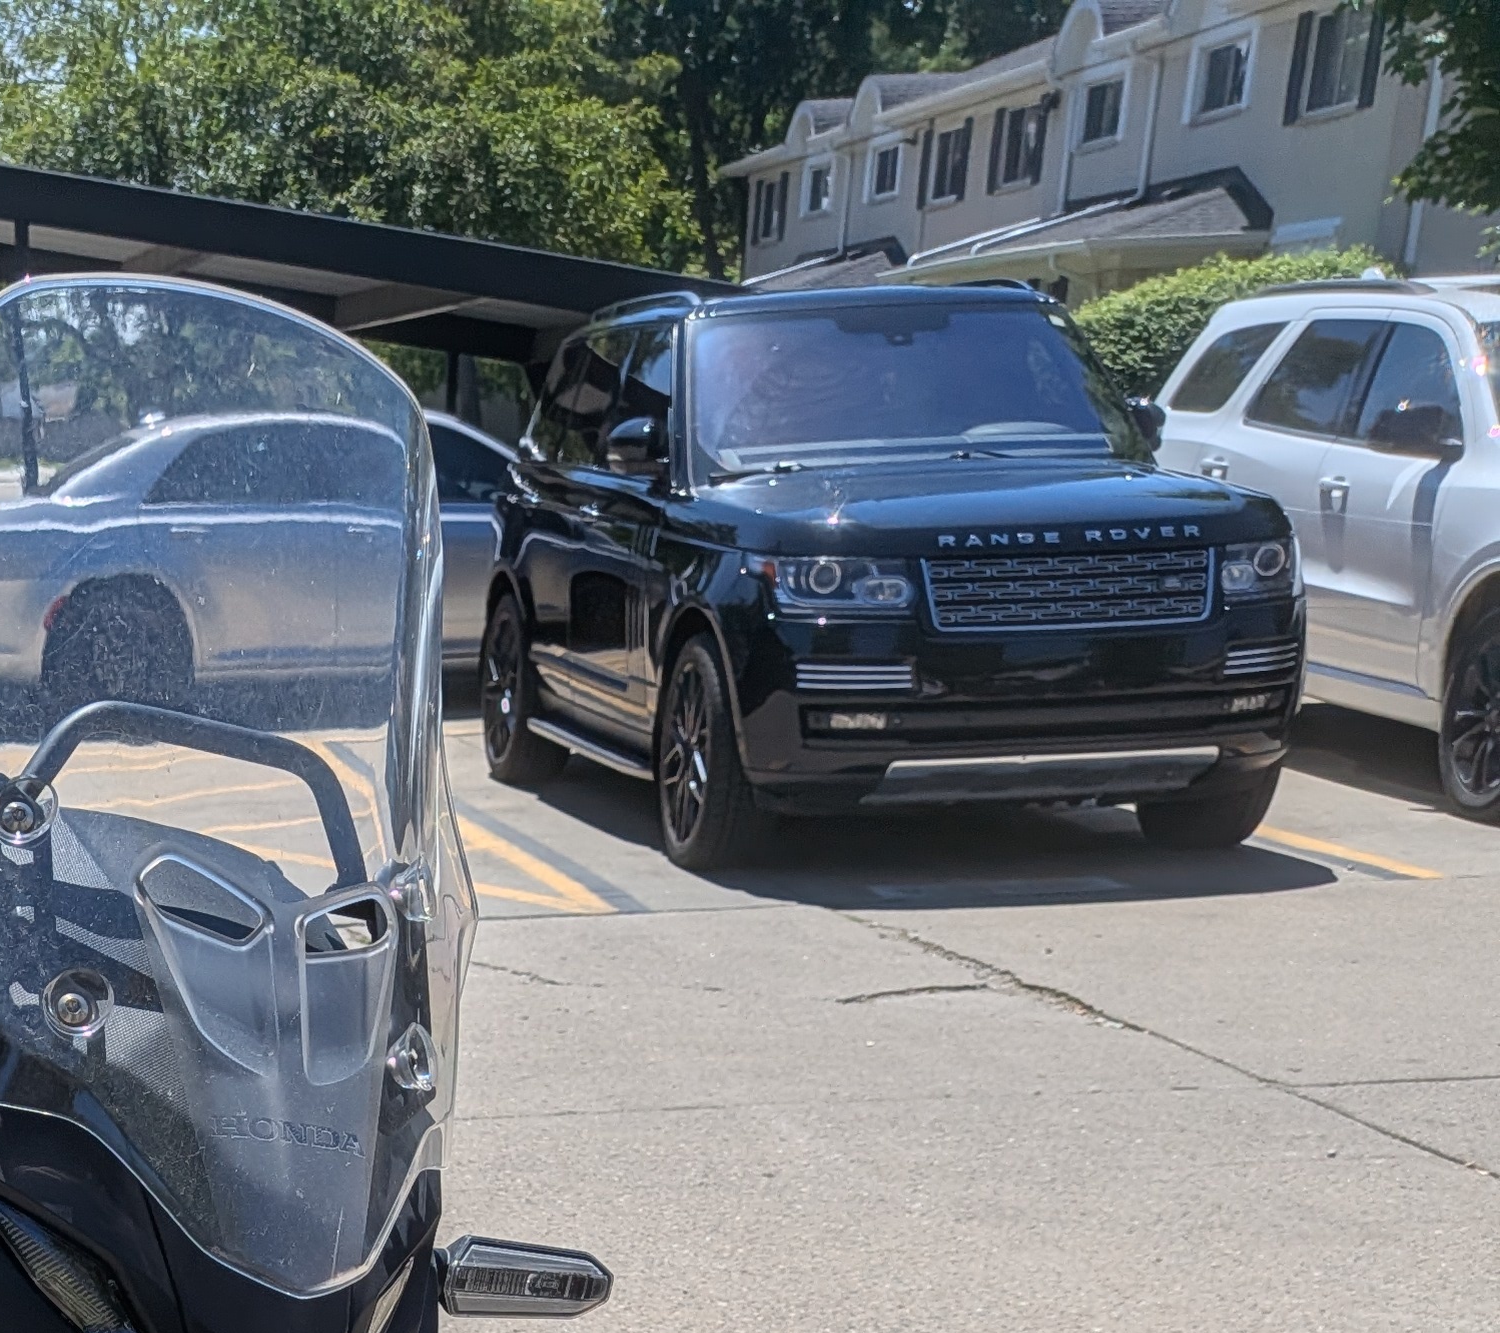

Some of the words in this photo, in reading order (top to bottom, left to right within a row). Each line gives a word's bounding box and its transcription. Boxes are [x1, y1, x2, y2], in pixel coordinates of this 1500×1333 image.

[938, 532, 1060, 548] RANGE
[1084, 525, 1200, 542] ROVER
[210, 1114, 366, 1158] HONDA
